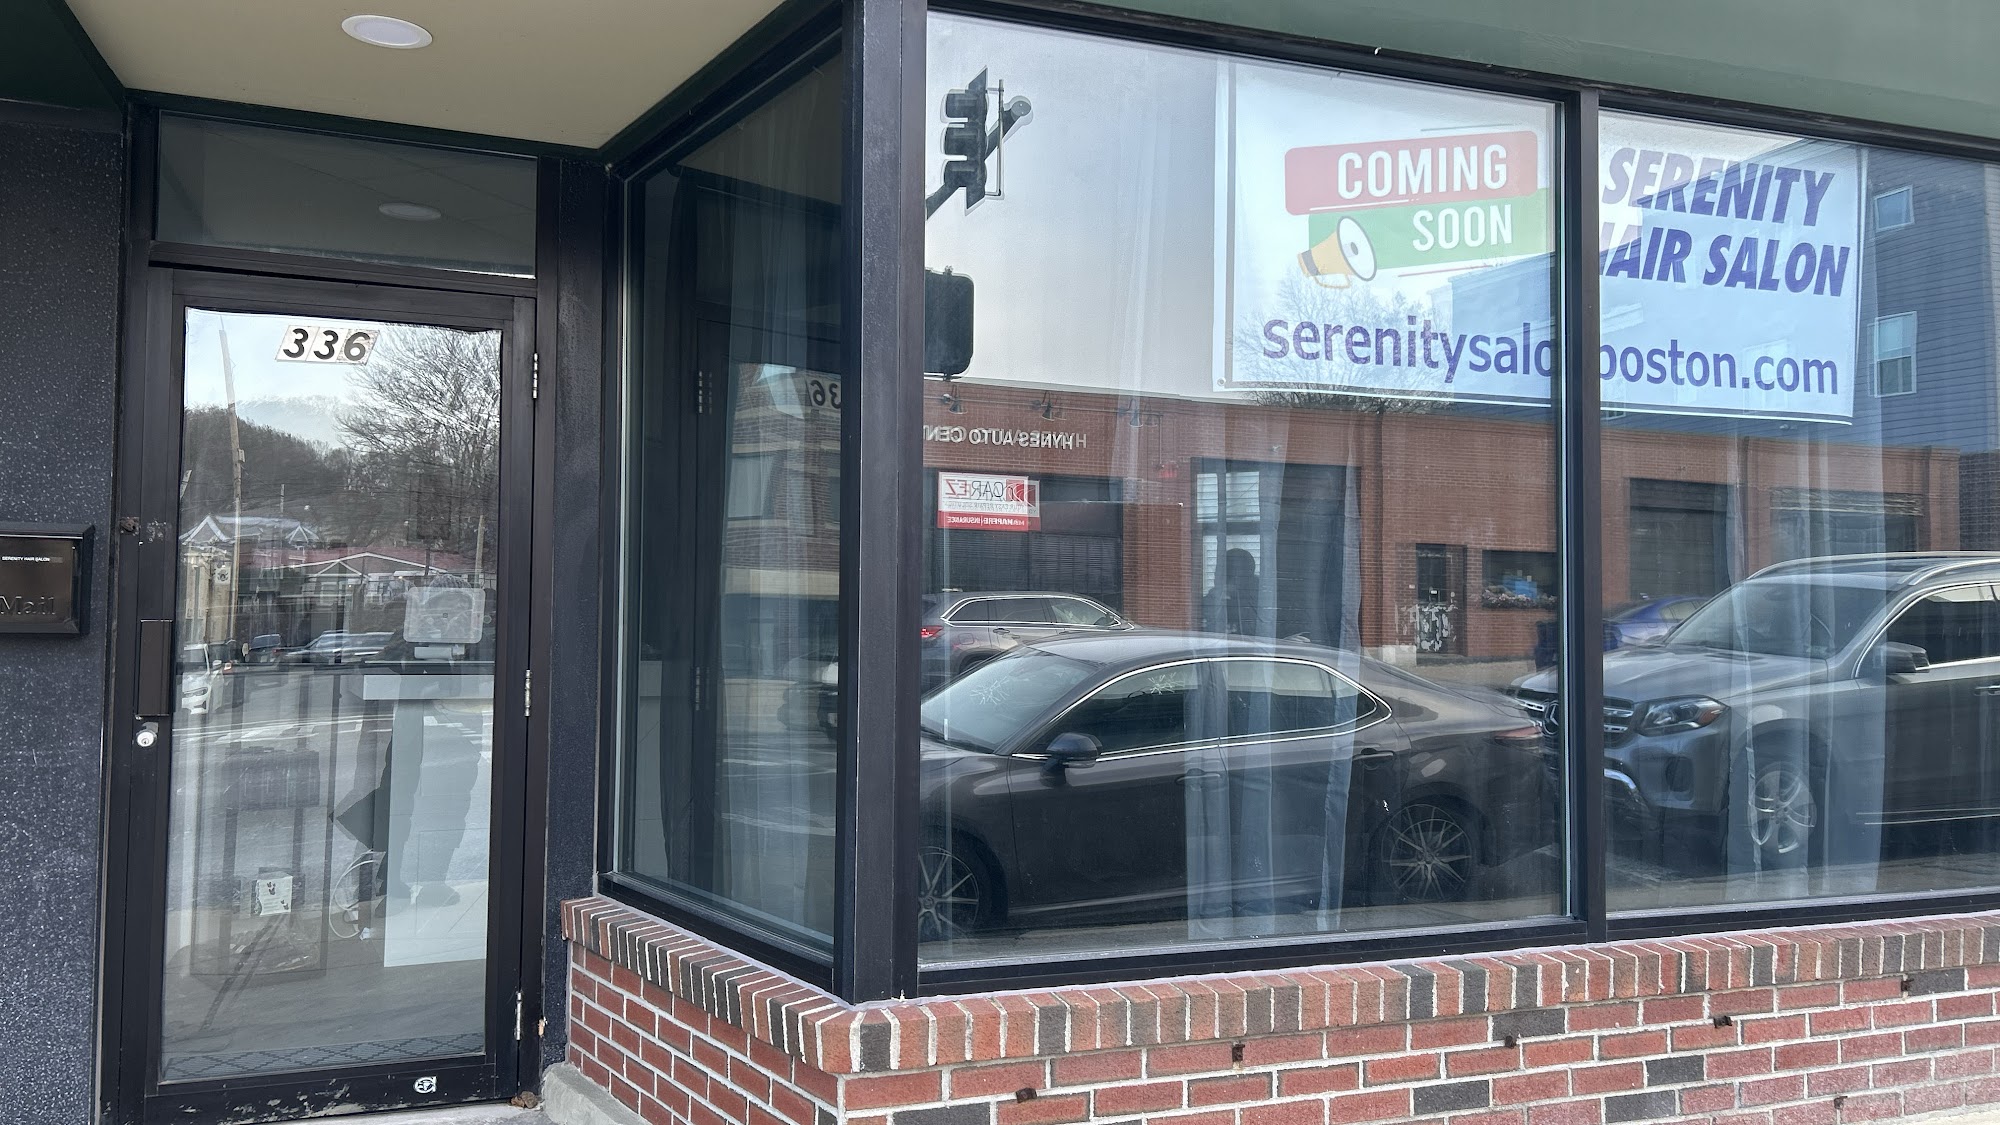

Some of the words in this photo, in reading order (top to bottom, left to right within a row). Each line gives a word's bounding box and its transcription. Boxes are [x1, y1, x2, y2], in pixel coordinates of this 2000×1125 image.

[1338, 144, 1507, 199] COMING
[1601, 147, 1836, 227] SERENITY
[1412, 204, 1512, 251] SOON
[1702, 234, 1850, 297] SALON
[283, 327, 371, 362] 336
[0, 595, 56, 615] Mail
